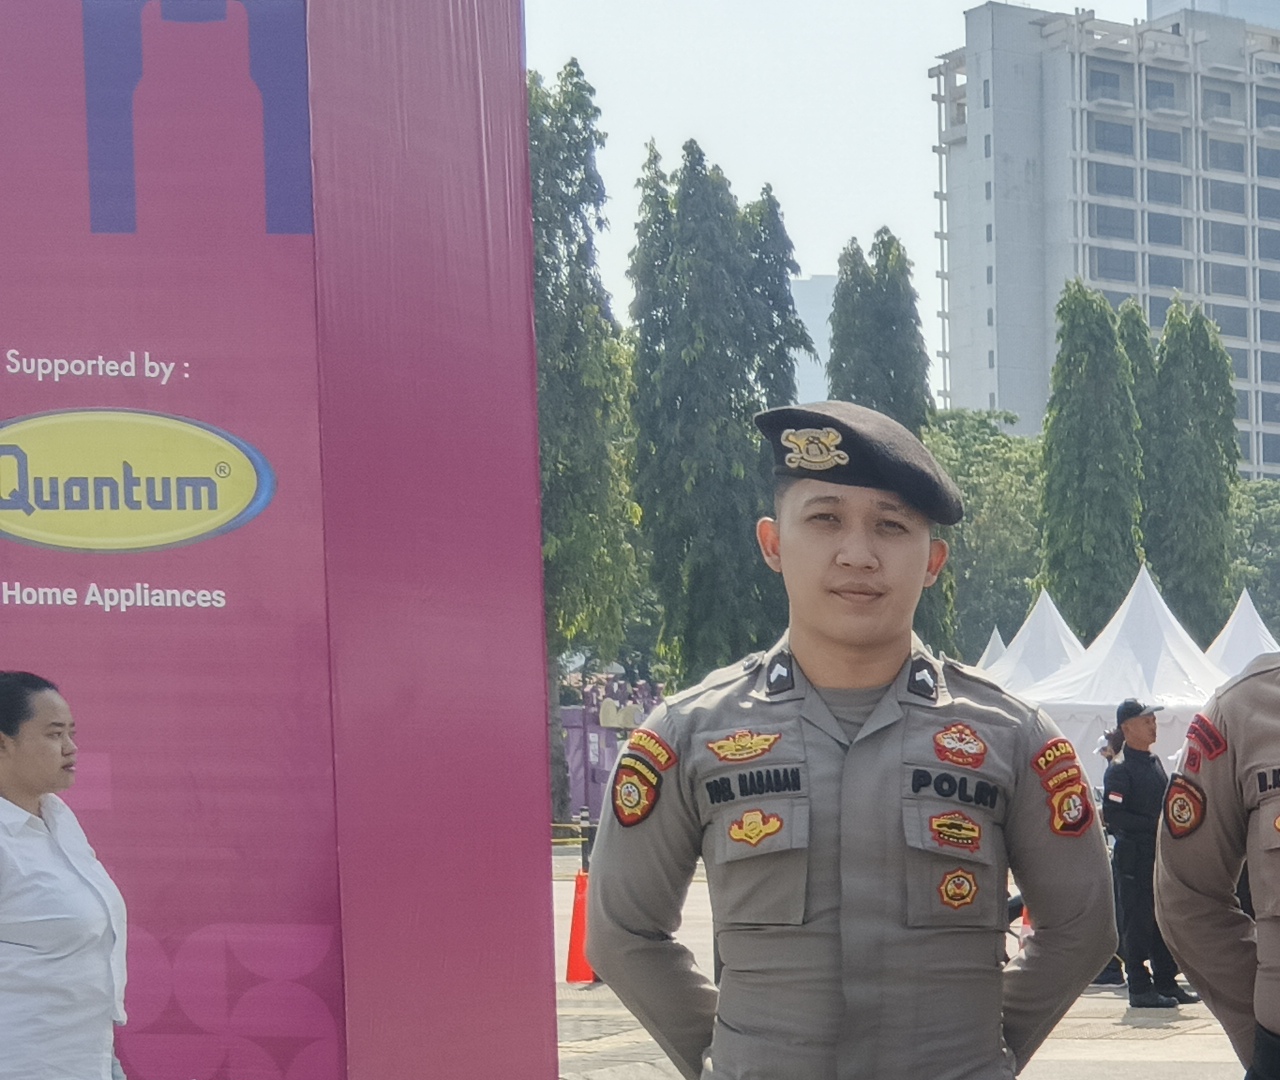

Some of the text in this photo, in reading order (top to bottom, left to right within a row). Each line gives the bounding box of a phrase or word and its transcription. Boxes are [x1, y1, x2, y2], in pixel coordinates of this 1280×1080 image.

[5, 349, 137, 382] Supported
[144, 352, 176, 385] by
[2, 582, 226, 612] Home Appliances
[1038, 742, 1073, 770] POLDA
[912, 769, 998, 809] POLRI
